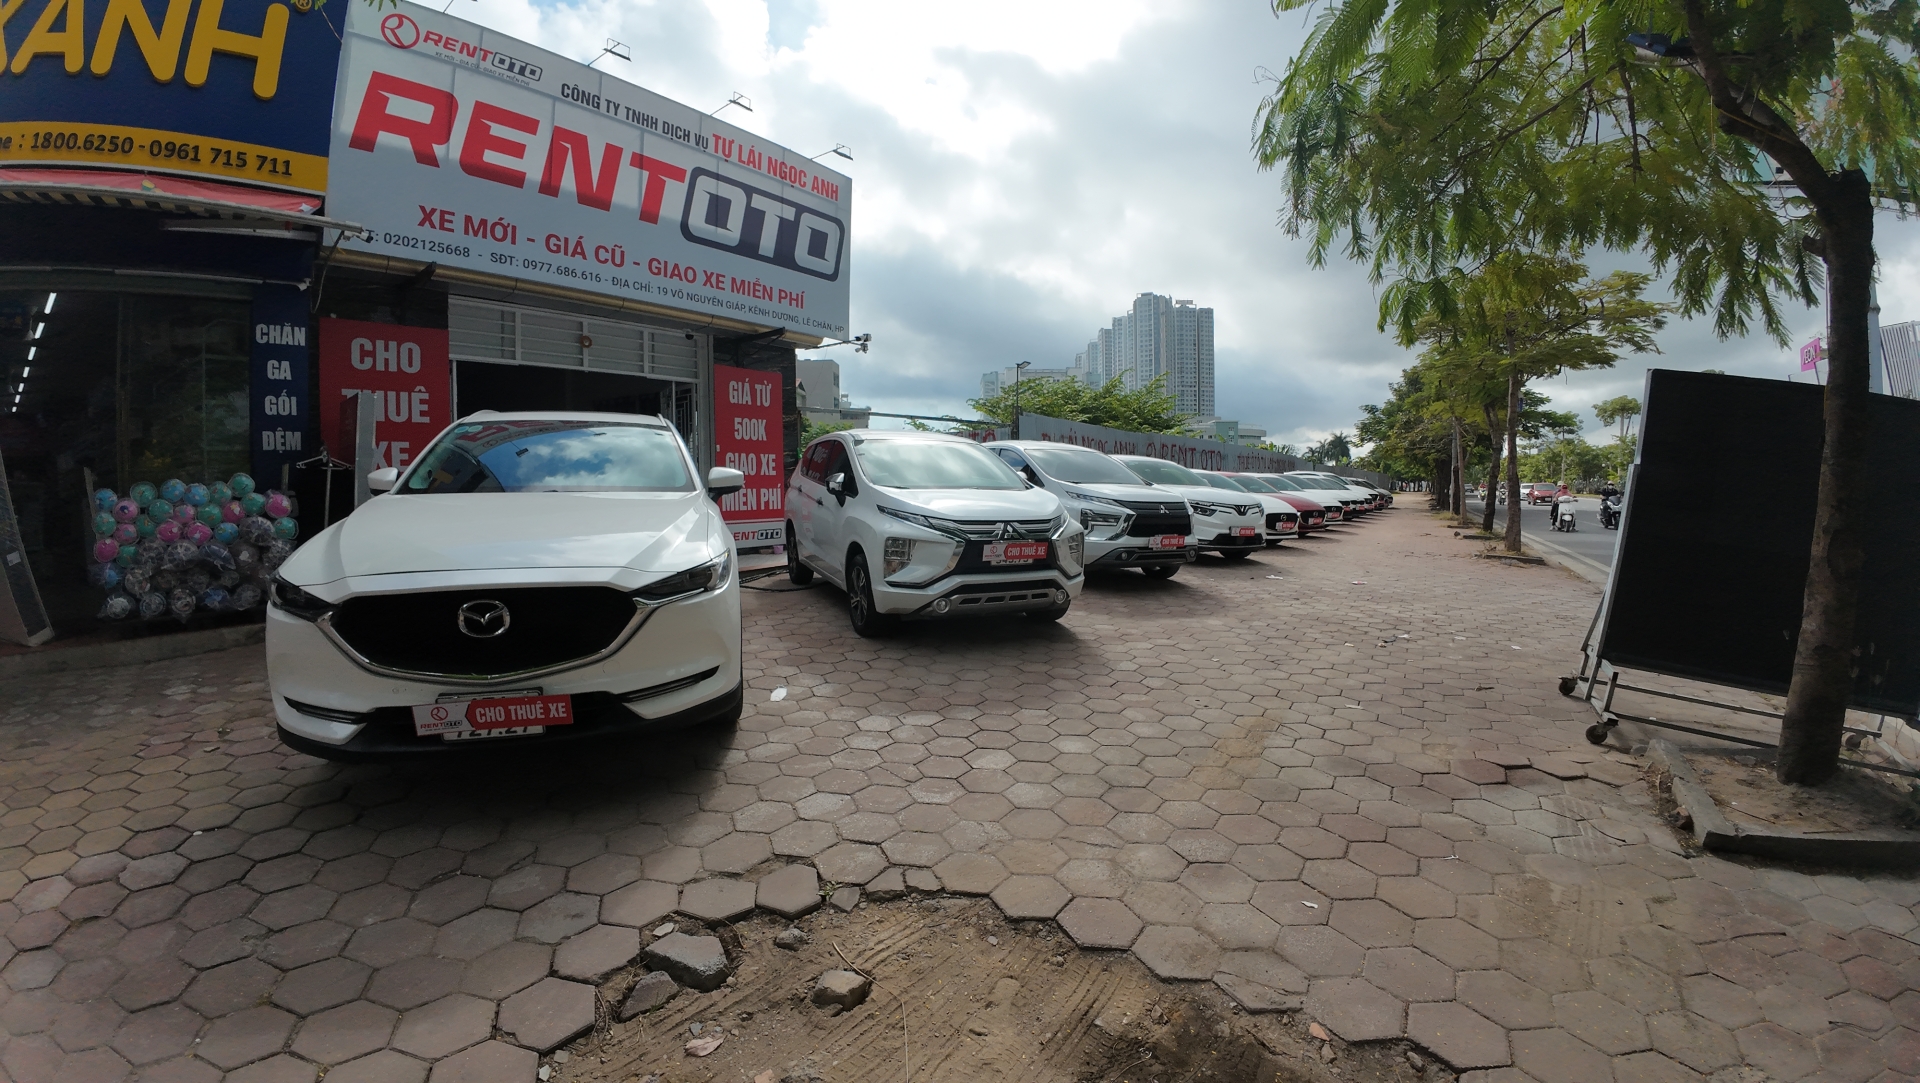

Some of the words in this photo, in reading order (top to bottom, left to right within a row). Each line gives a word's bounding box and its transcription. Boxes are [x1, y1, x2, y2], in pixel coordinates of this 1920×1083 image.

[423, 30, 543, 82] RENTOTO
[435, 51, 443, 59] XE
[497, 71, 506, 79] XE
[31, 131, 134, 154] 1800.6250
[150, 140, 200, 162] 0961
[210, 148, 248, 168] 715
[256, 155, 292, 177] 711
[561, 83, 601, 110] CÔNG
[604, 98, 621, 117] TY
[624, 106, 659, 131] TNHH
[662, 121, 691, 143] DỊCH
[694, 132, 709, 152] VỤ
[712, 134, 735, 162] TỰ
[737, 145, 762, 171] LÁI
[767, 156, 807, 188] NGỌC
[811, 175, 839, 202] ANH
[349, 71, 845, 282] RENTOTO
[417, 204, 456, 233] XE
[463, 214, 517, 245] MỚI
[545, 233, 588, 261] GIÁ
[594, 244, 625, 268] CŨ
[647, 257, 697, 284] GIAO
[702, 270, 726, 291] XE
[730, 277, 774, 303] MIỄN
[778, 289, 806, 310] PHÍ
[383, 232, 470, 258] 0202125668
[490, 251, 519, 267] SĐT:
[522, 258, 602, 283] 0977.686.616
[611, 276, 630, 290] ĐỊA
[632, 279, 654, 294] CHỈ:
[656, 286, 668, 297] 19
[671, 287, 685, 300] VÕ
[686, 292, 724, 308] NGUYÊN
[725, 299, 747, 314] GIÁP,
[748, 304, 771, 318] KÊNH
[772, 309, 801, 326] DƯƠNG,
[802, 315, 811, 326] LÊ
[812, 317, 834, 332] CHÂN,
[835, 325, 845, 334] HP
[255, 322, 306, 346] CHĂN
[350, 337, 422, 374] CHO
[266, 360, 292, 381] GA
[264, 389, 298, 416] GỐI
[728, 378, 752, 406] GIÁ
[755, 380, 772, 407] TỪ
[734, 417, 767, 441] 500K
[725, 452, 757, 476] GIAO
[760, 453, 777, 476] XE
[760, 483, 782, 510] PHÍ
[734, 528, 782, 541] ENTOTO
[1007, 547, 1020, 556] CHO
[1021, 546, 1036, 556] THUÊ
[1037, 546, 1046, 555] XE
[420, 720, 462, 729] RENTOTO
[475, 706, 505, 723] CHO
[508, 700, 545, 720] THUÊ
[549, 702, 567, 718] XE
